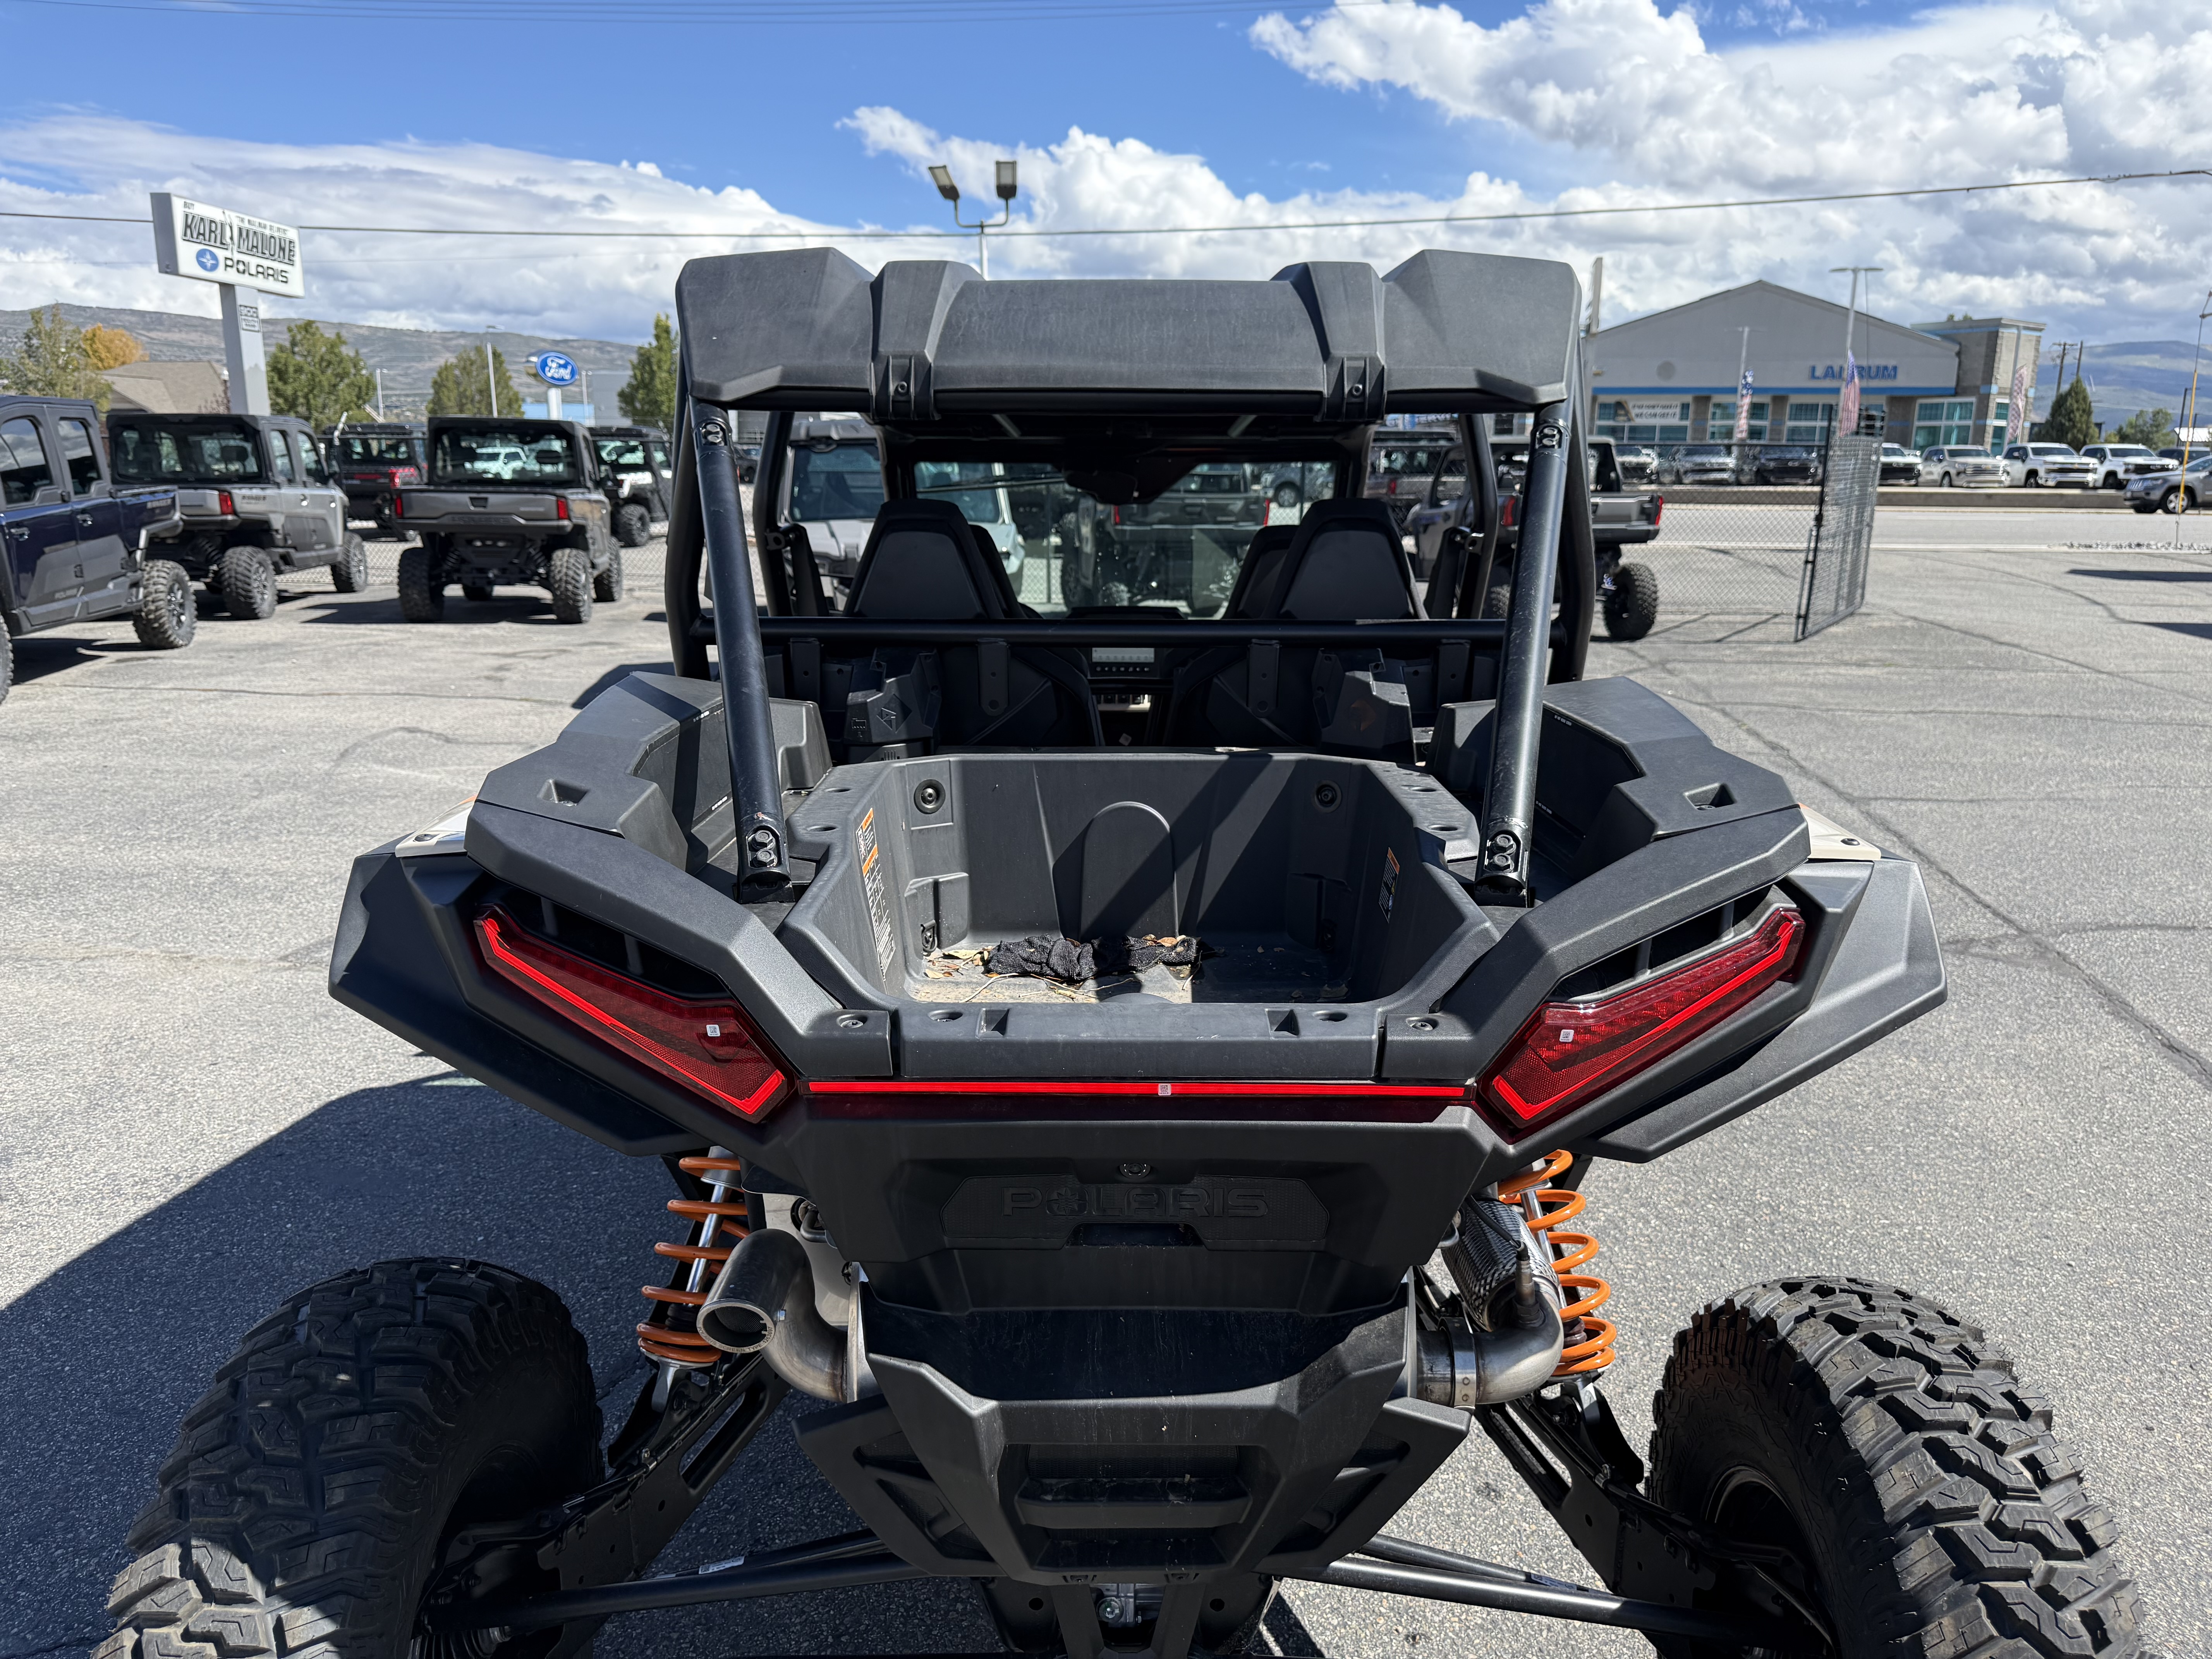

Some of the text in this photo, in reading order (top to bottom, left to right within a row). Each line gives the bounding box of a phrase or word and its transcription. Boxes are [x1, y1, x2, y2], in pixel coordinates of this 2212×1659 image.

[182, 211, 295, 266] KARL MALONE
[224, 256, 289, 284] POLARIS
[545, 356, 572, 380] Ford
[1809, 365, 1897, 381] LARUM
[1002, 1187, 1269, 1218] POLARIS
[747, 1343, 763, 1352] TYPE
